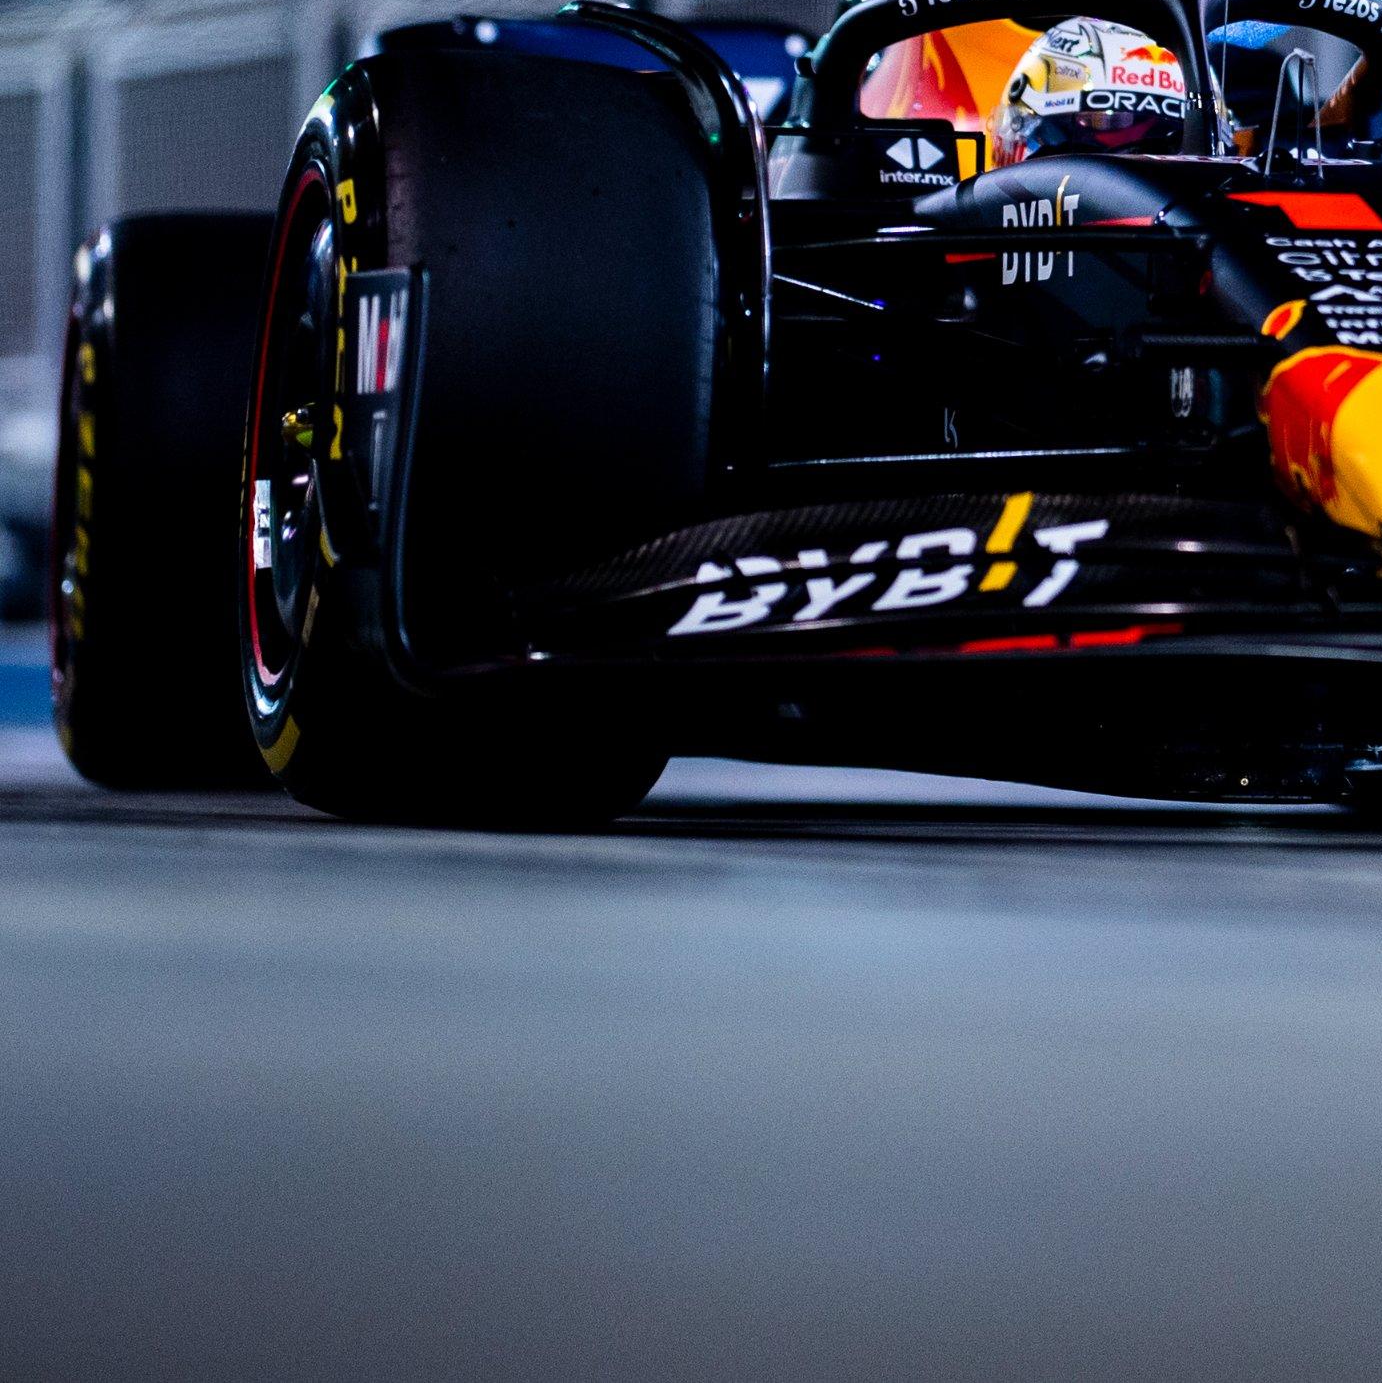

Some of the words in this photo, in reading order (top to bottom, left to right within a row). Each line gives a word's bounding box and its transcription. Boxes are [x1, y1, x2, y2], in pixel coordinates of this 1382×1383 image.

[1111, 66, 1155, 88] Red
[1158, 70, 1185, 93] Bu
[879, 169, 955, 186] inter.mx
